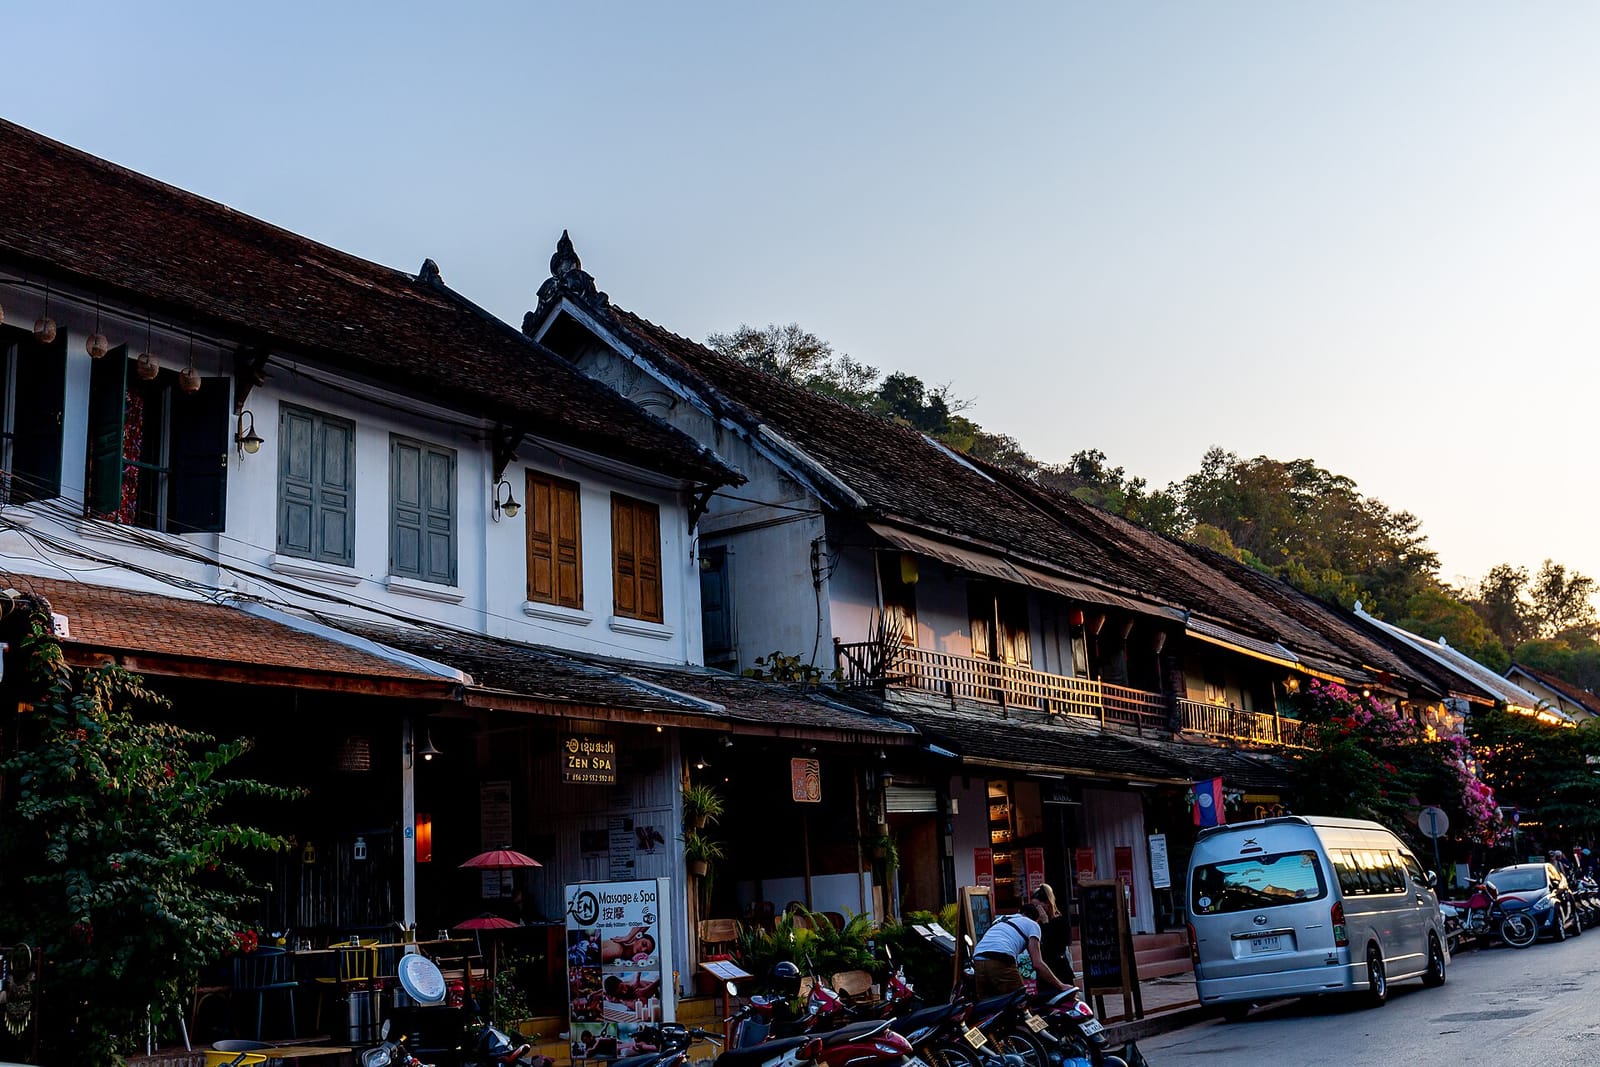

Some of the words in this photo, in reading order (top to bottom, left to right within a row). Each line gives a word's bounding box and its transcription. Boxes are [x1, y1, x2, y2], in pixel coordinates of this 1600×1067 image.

[568, 755, 588, 768] ZEN
[592, 757, 612, 770] SPA
[598, 891, 632, 905] Massage
[633, 893, 639, 903] &
[639, 890, 655, 904] Spa
[602, 907, 625, 920] 按摩
